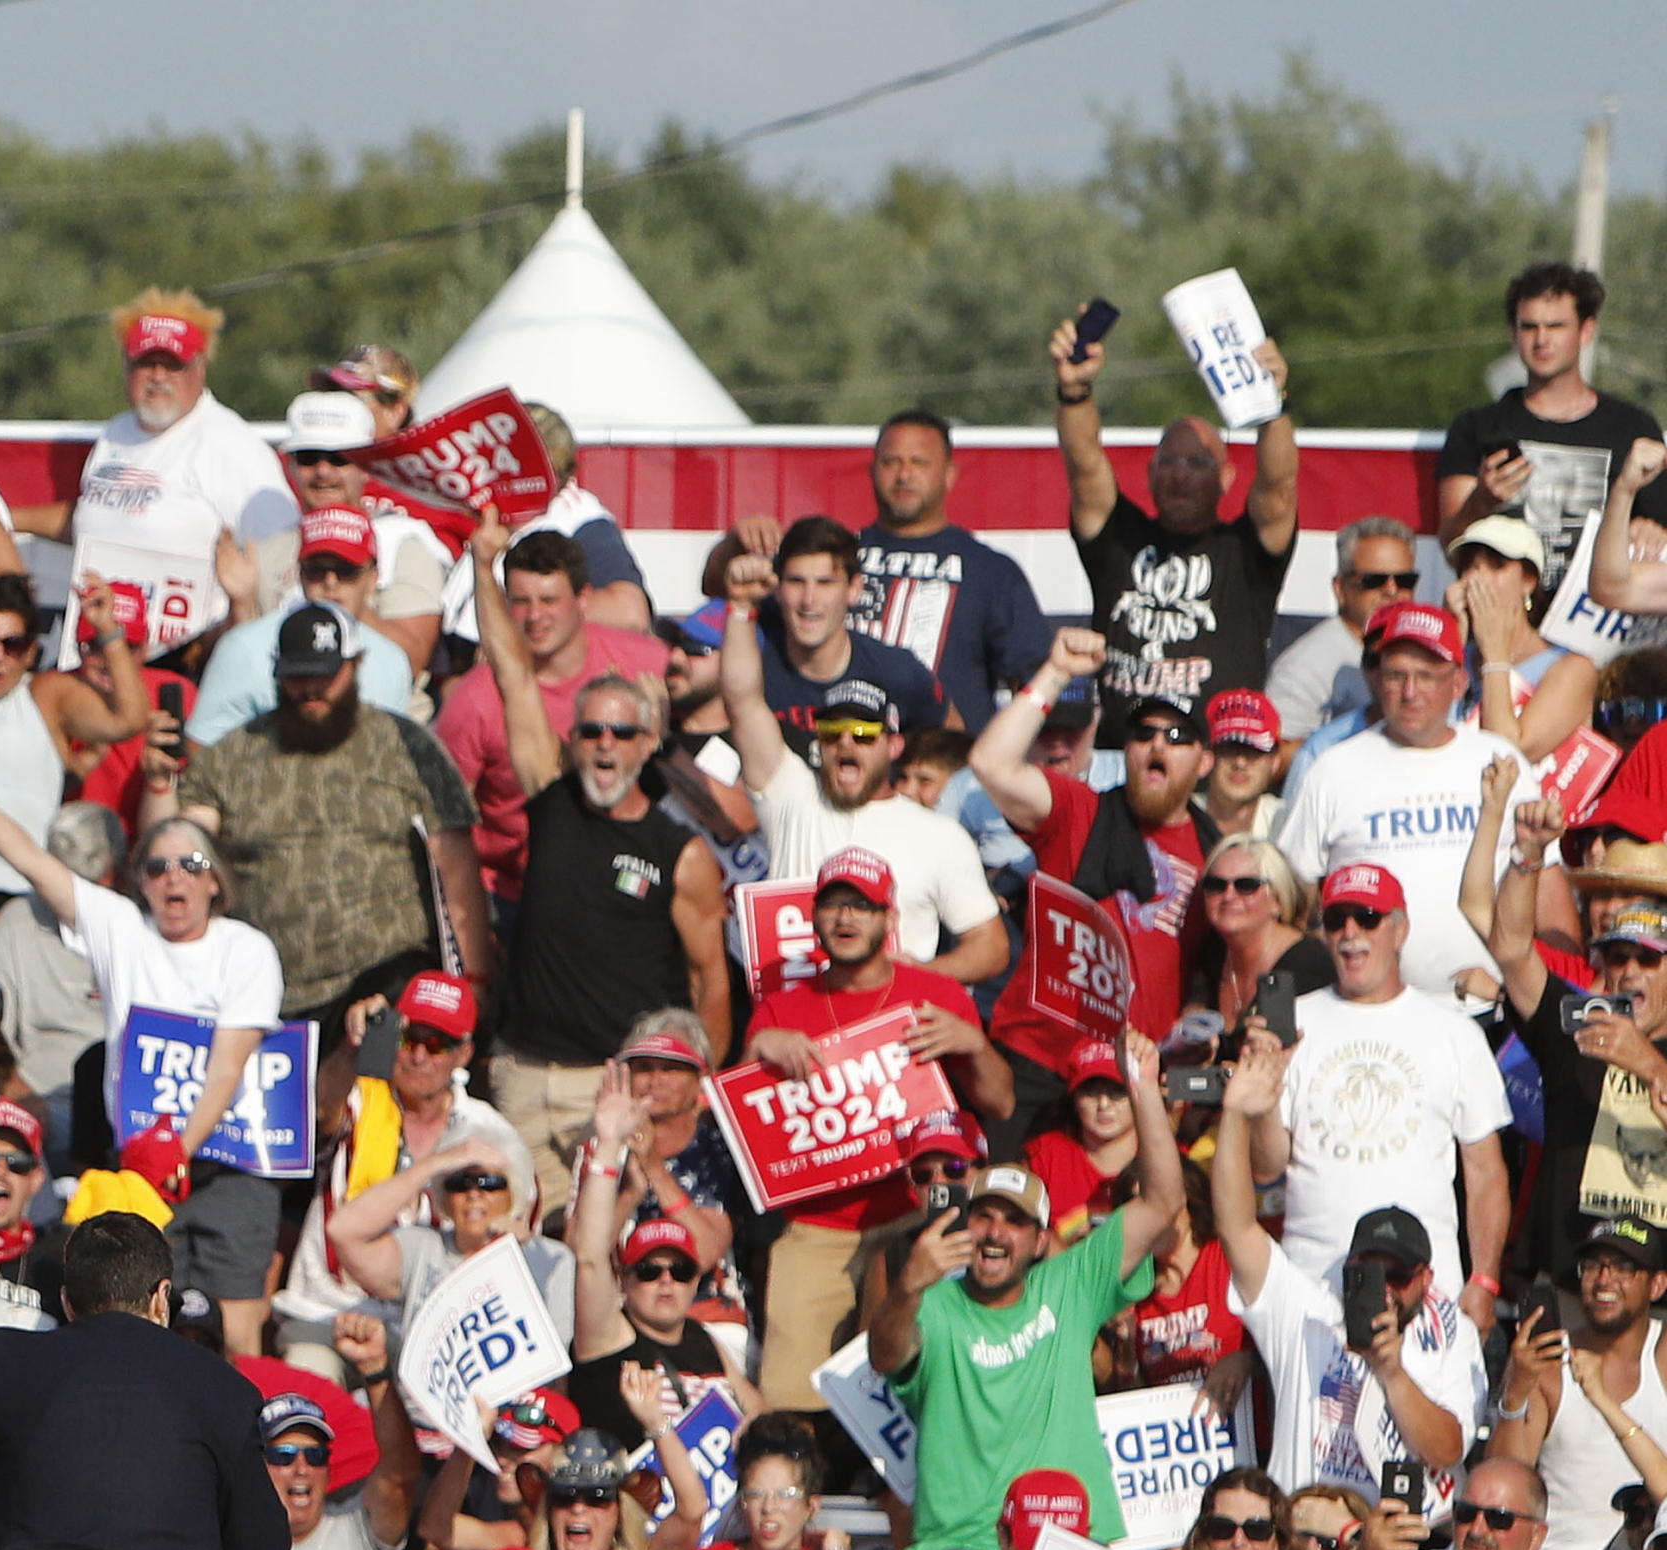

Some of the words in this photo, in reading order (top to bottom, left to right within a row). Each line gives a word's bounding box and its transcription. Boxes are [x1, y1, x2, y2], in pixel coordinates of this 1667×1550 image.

[1365, 807, 1479, 841] TRUM
[153, 1077, 272, 1122] 204
[744, 1042, 911, 1124] TRUMP
[783, 1084, 908, 1151] 2024
[1023, 1495, 1048, 1511] MAKE
